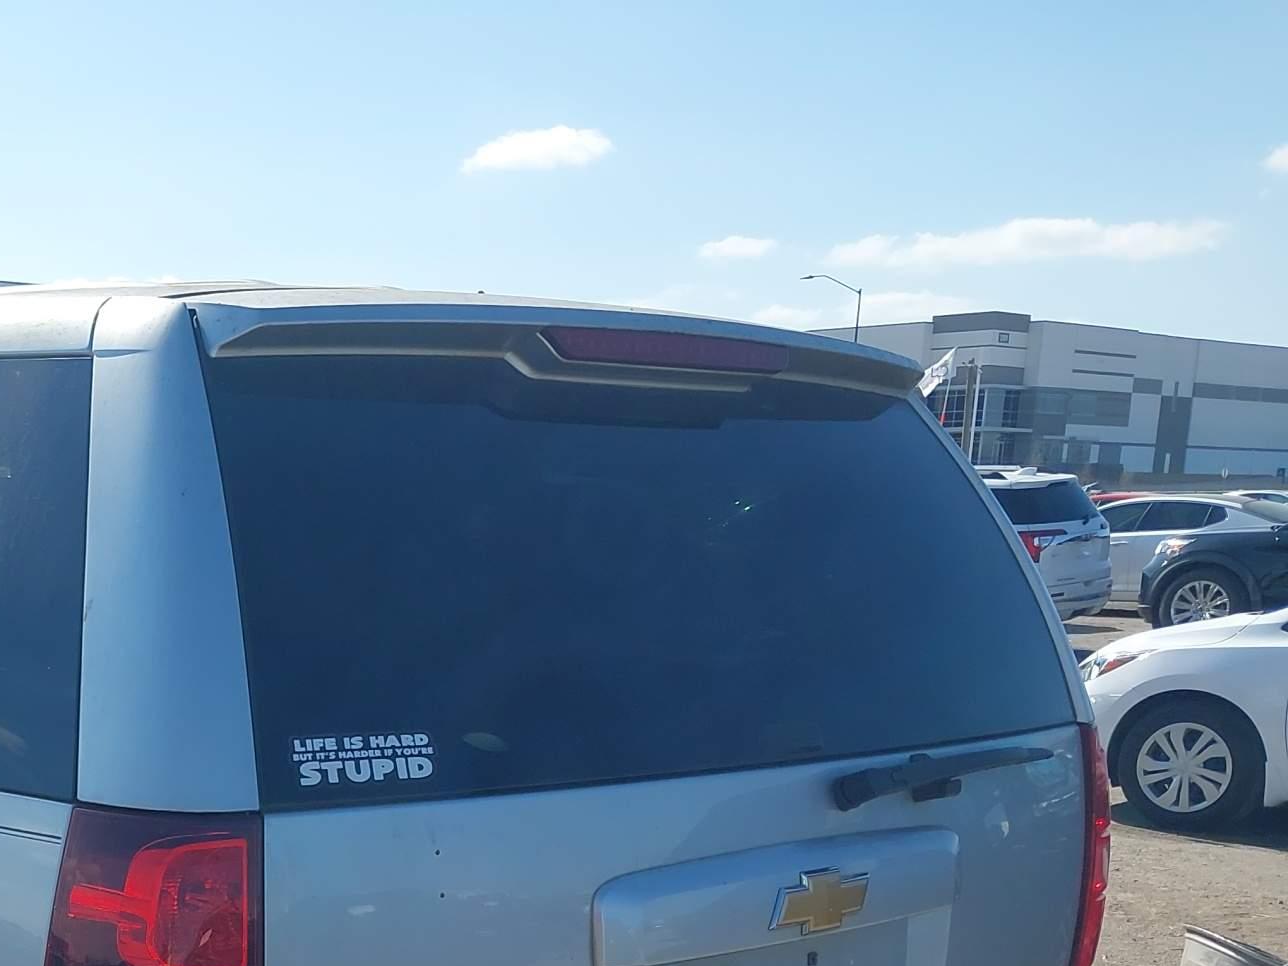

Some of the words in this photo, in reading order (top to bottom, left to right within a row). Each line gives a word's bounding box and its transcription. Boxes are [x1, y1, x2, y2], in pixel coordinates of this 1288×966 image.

[293, 737, 338, 752] LIFE
[343, 736, 364, 750] IS
[369, 733, 429, 749] HARD
[293, 753, 313, 761] BUT
[316, 751, 336, 760] IT'S
[338, 749, 382, 759] HARDER
[384, 748, 393, 757] IF
[396, 746, 434, 756] YOU'RE
[299, 756, 433, 786] STUPID
